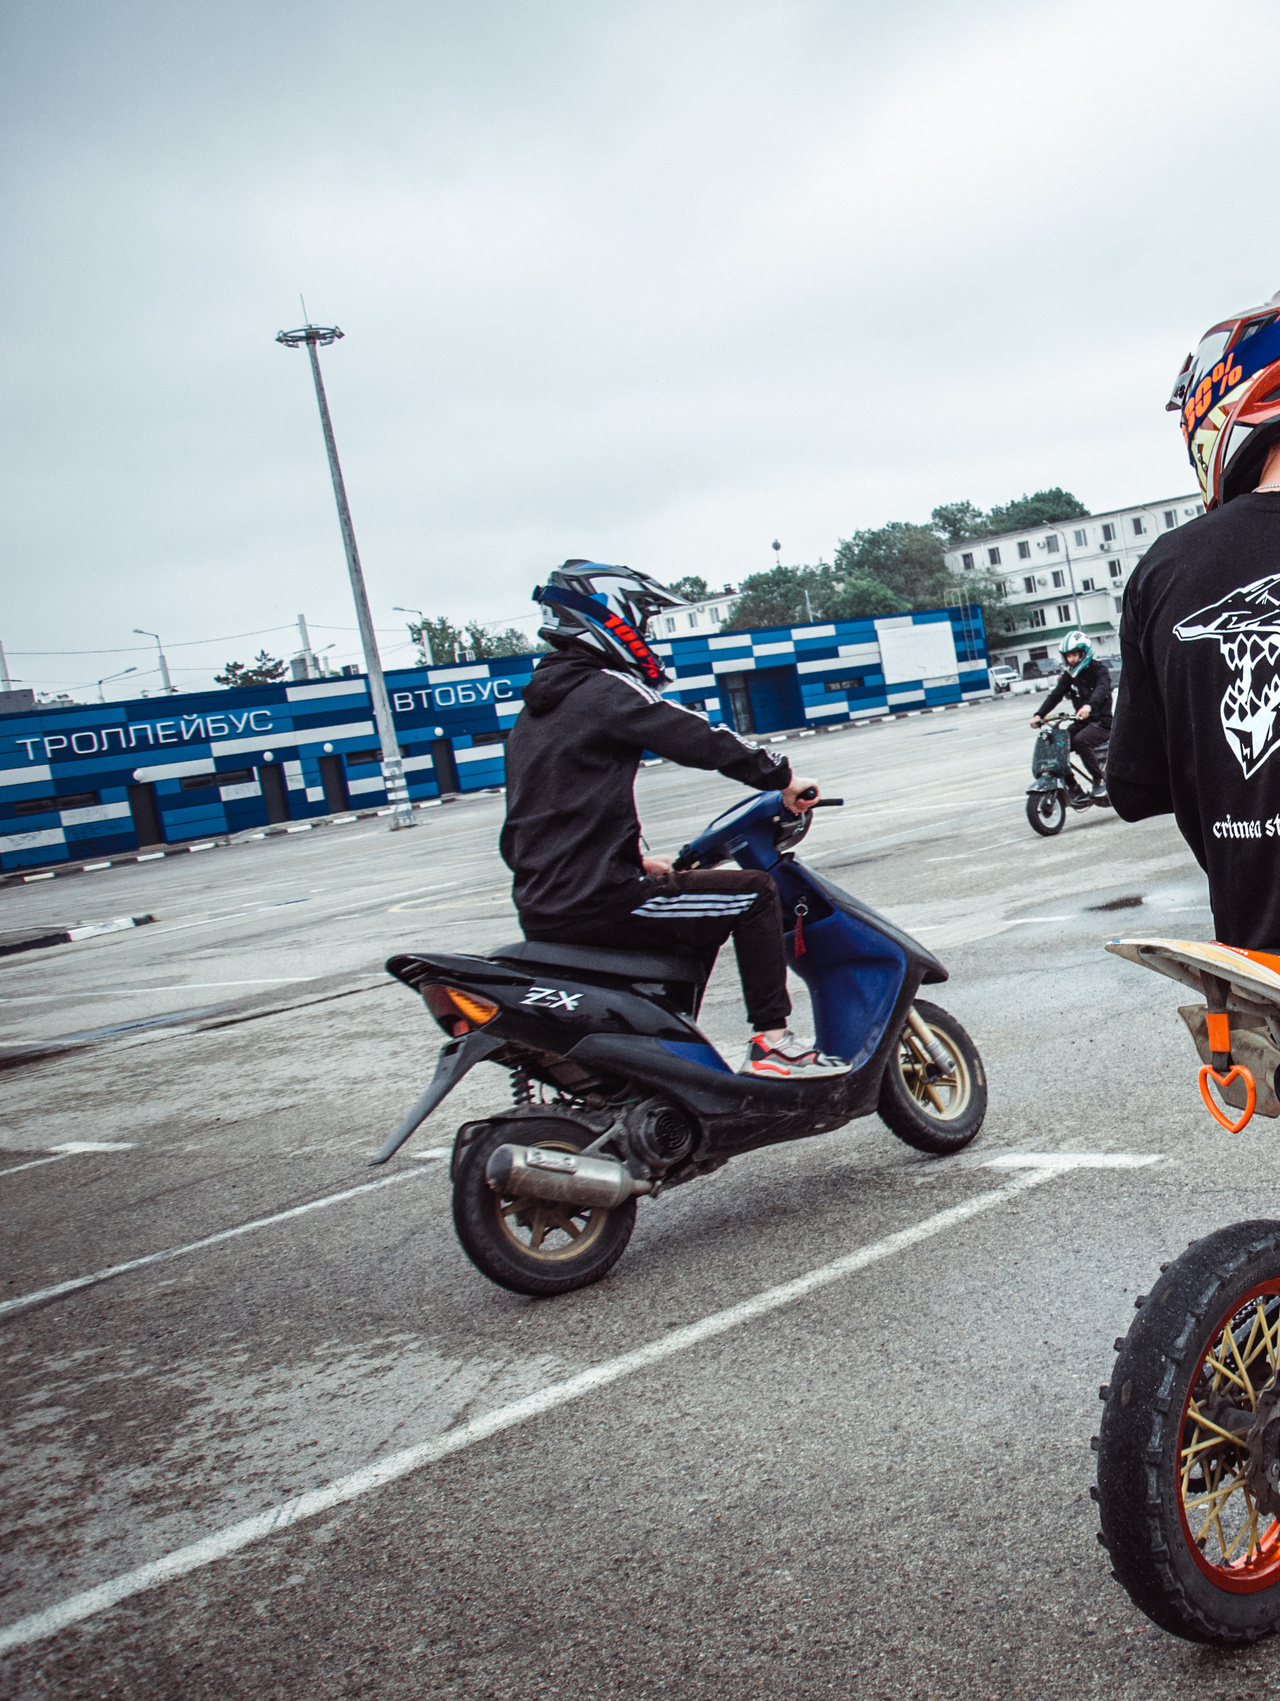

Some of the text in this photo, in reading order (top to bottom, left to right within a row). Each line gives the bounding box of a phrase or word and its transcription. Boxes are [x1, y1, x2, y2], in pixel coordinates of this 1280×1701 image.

[604, 613, 660, 678] 100%
[373, 679, 513, 715] ВТОБУС
[16, 709, 274, 761] ТРОЛЛЕЙБУС
[1212, 813, 1262, 839] crimea
